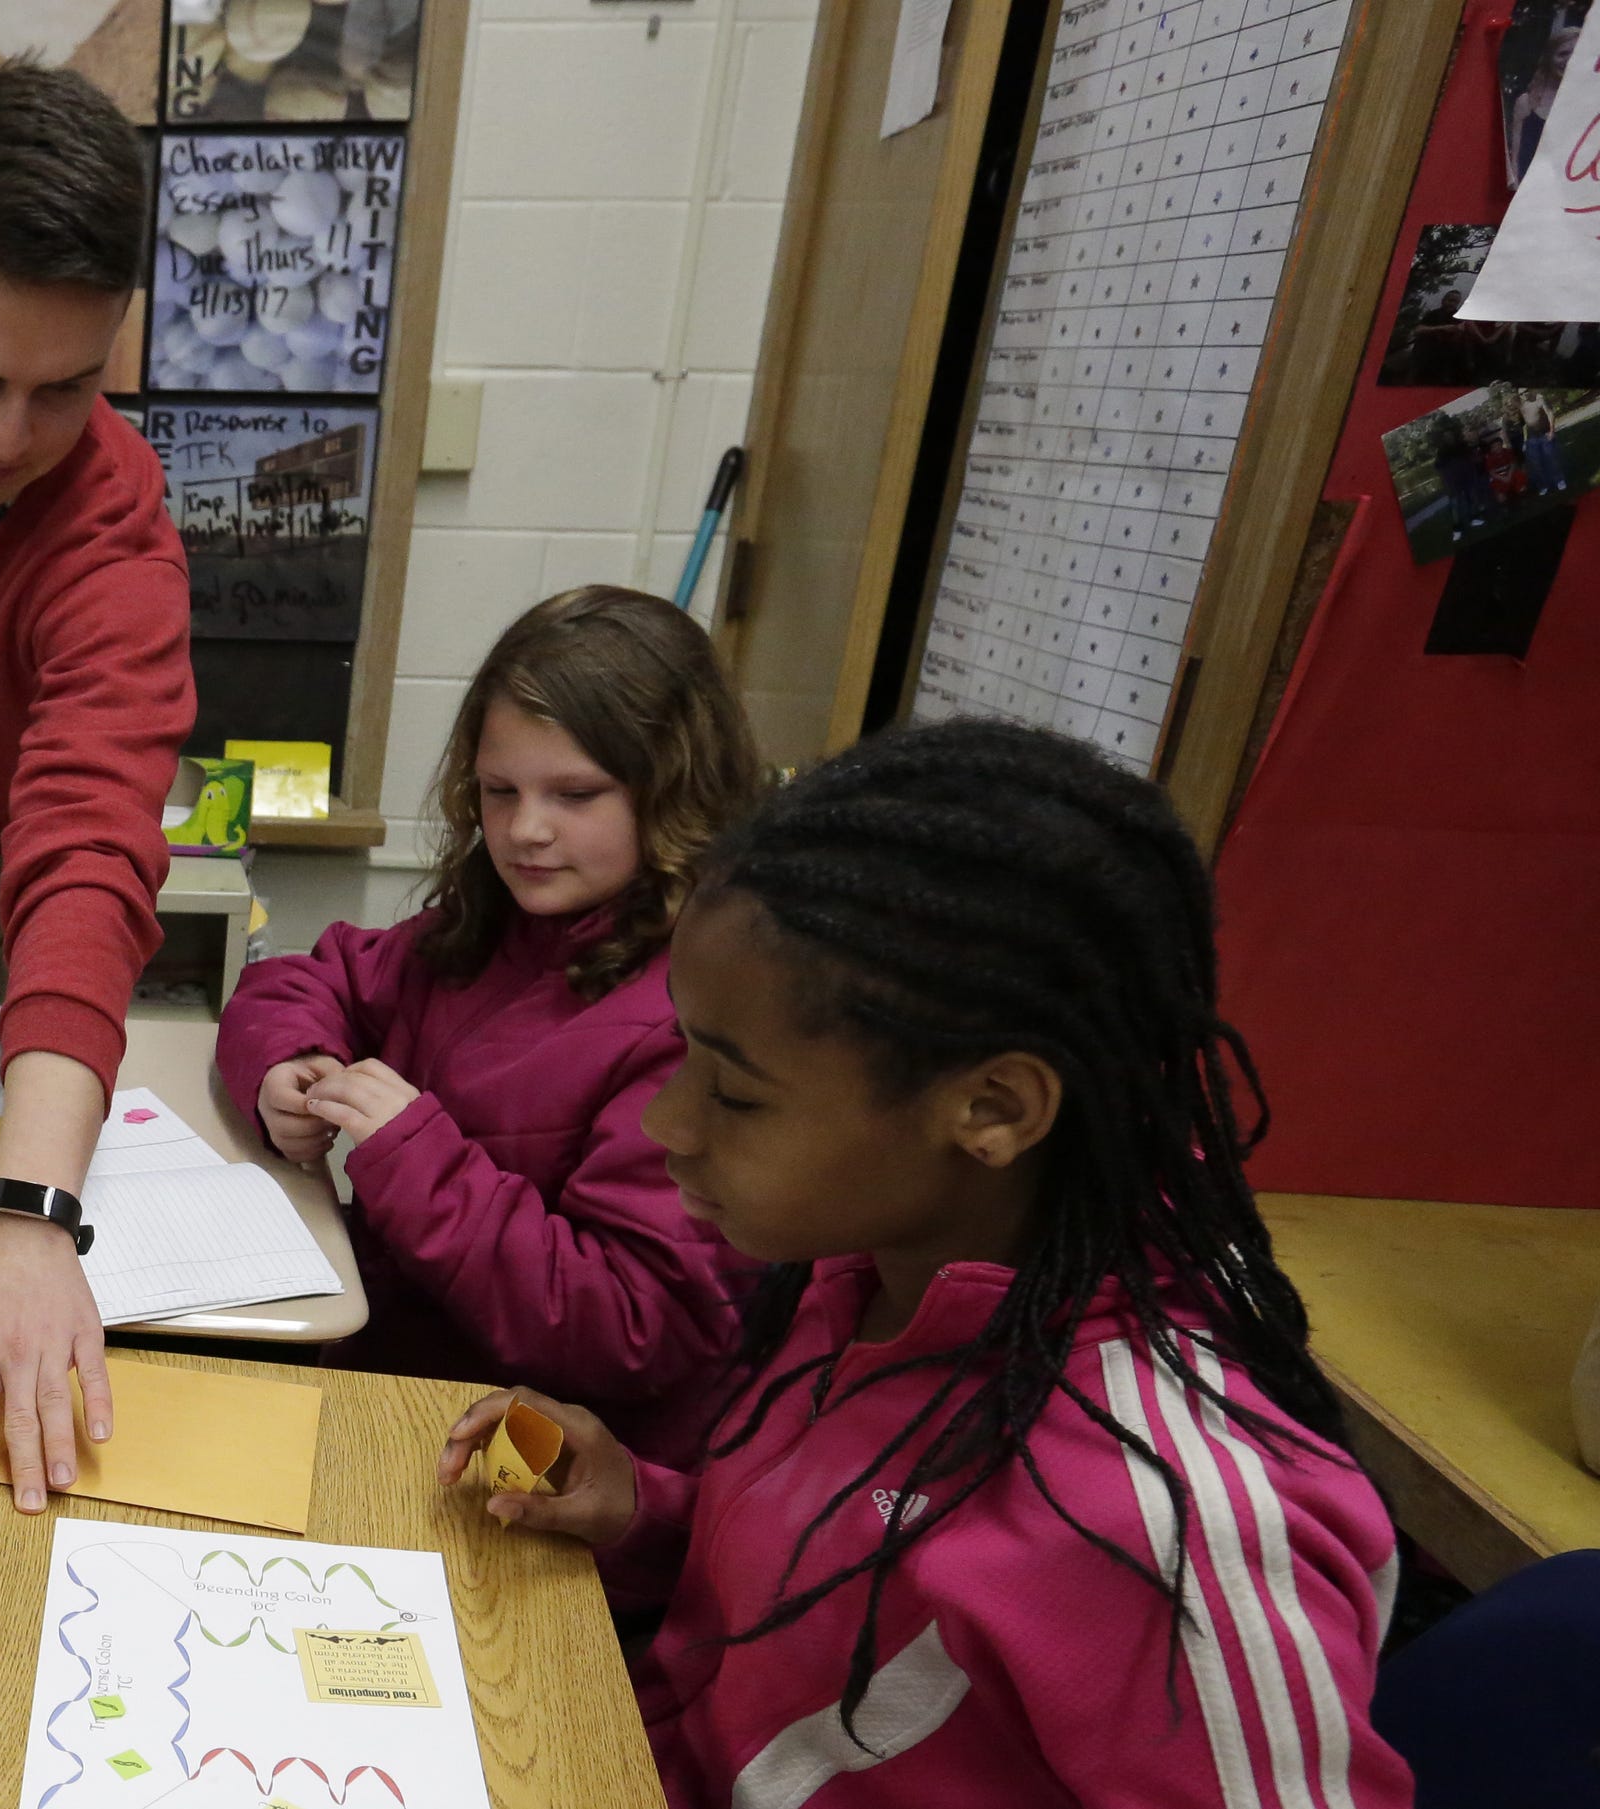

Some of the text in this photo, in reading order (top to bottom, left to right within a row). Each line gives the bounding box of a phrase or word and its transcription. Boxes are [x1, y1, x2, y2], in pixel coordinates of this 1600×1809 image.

[169, 137, 304, 176] Chocolate
[167, 183, 262, 222] Essay
[168, 243, 227, 282] Due
[350, 142, 400, 375] WRITING
[183, 410, 329, 435] Response to
[175, 441, 235, 469] TFK
[194, 1581, 332, 1606] Decending Colon
[251, 1601, 276, 1612] DC
[95, 1634, 112, 1666] Colon
[342, 1651, 382, 1660] Bacteria
[117, 1674, 133, 1690] TC
[337, 1667, 378, 1676] Bacteria
[328, 1687, 418, 1700] Food Competition
